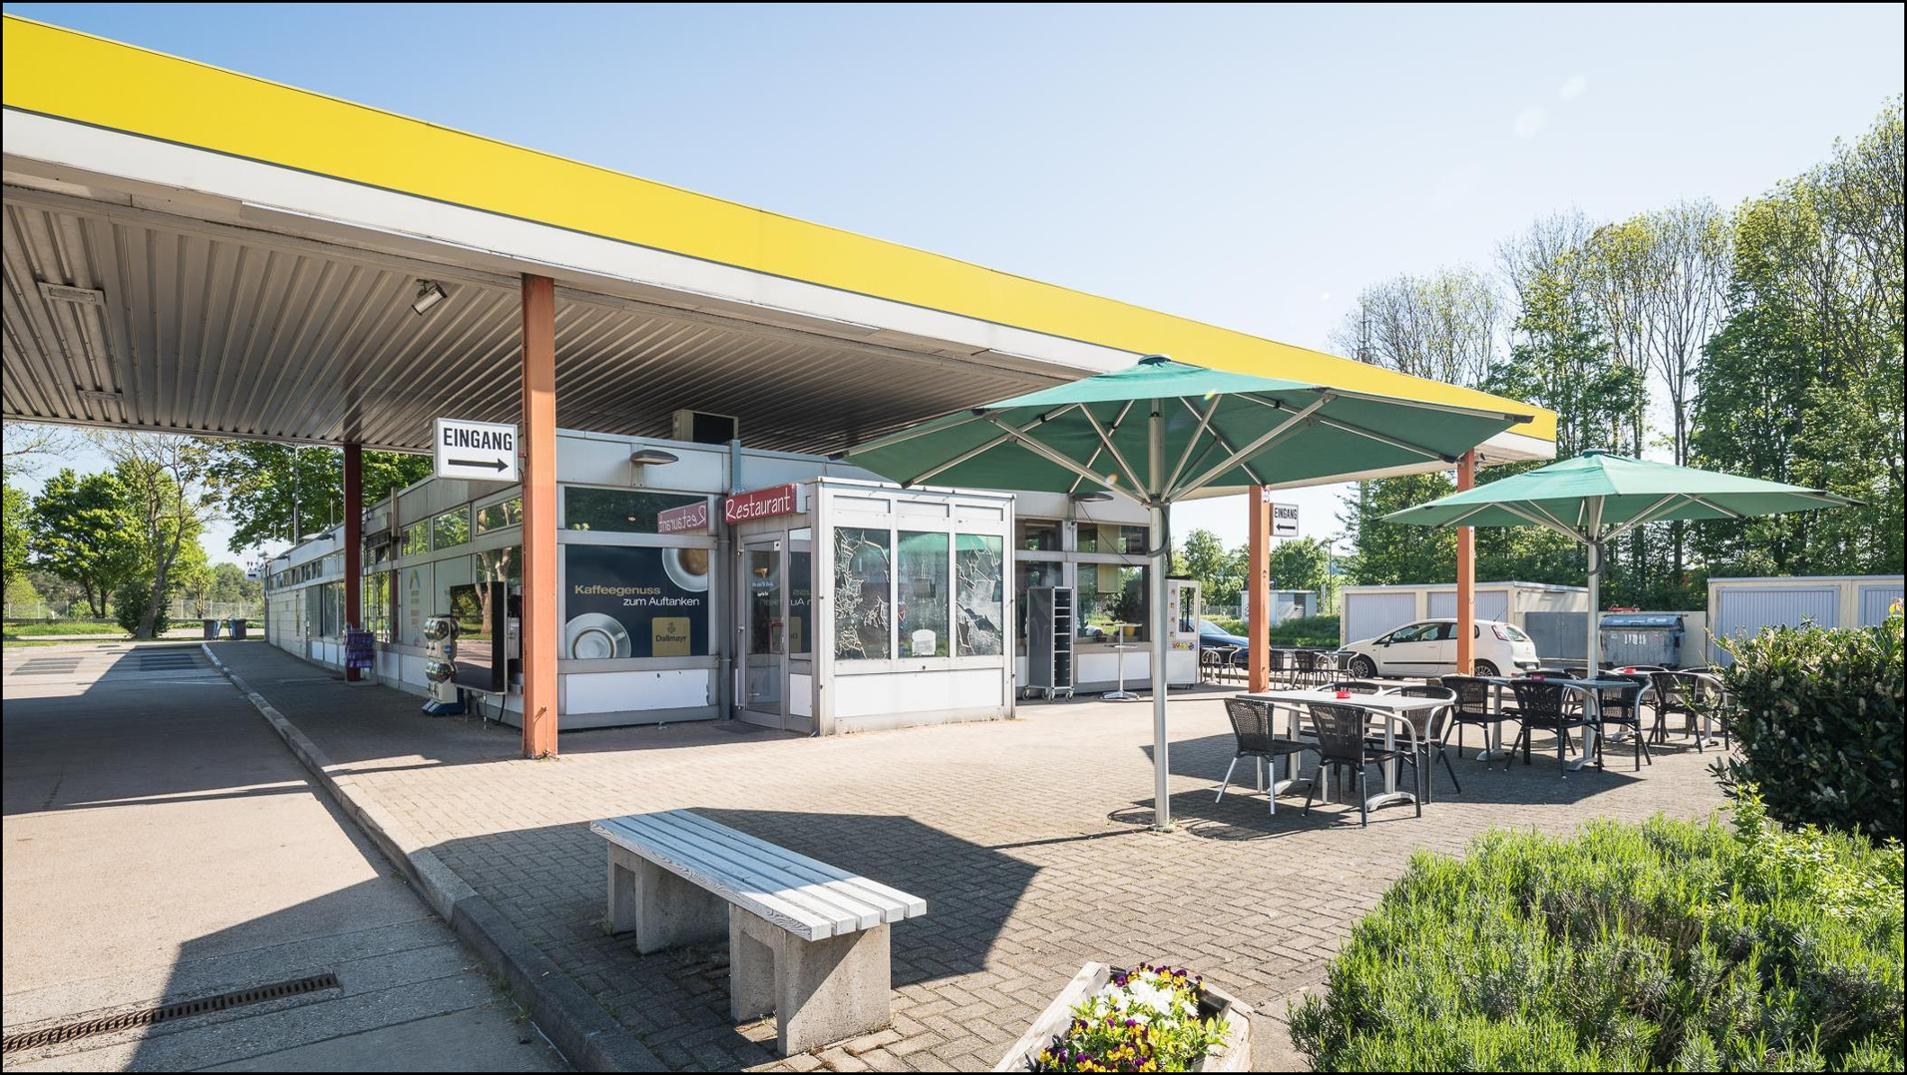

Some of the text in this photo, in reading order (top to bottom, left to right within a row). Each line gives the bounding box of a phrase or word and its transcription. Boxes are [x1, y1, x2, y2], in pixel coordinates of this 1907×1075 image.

[443, 428, 512, 451] EINGANG
[726, 488, 790, 520] Restaurant
[1274, 507, 1298, 520] EINGANG
[575, 585, 661, 596] Kaffeegenuss
[623, 596, 700, 607] zum Auftanken
[655, 634, 687, 643] Dallmayr
